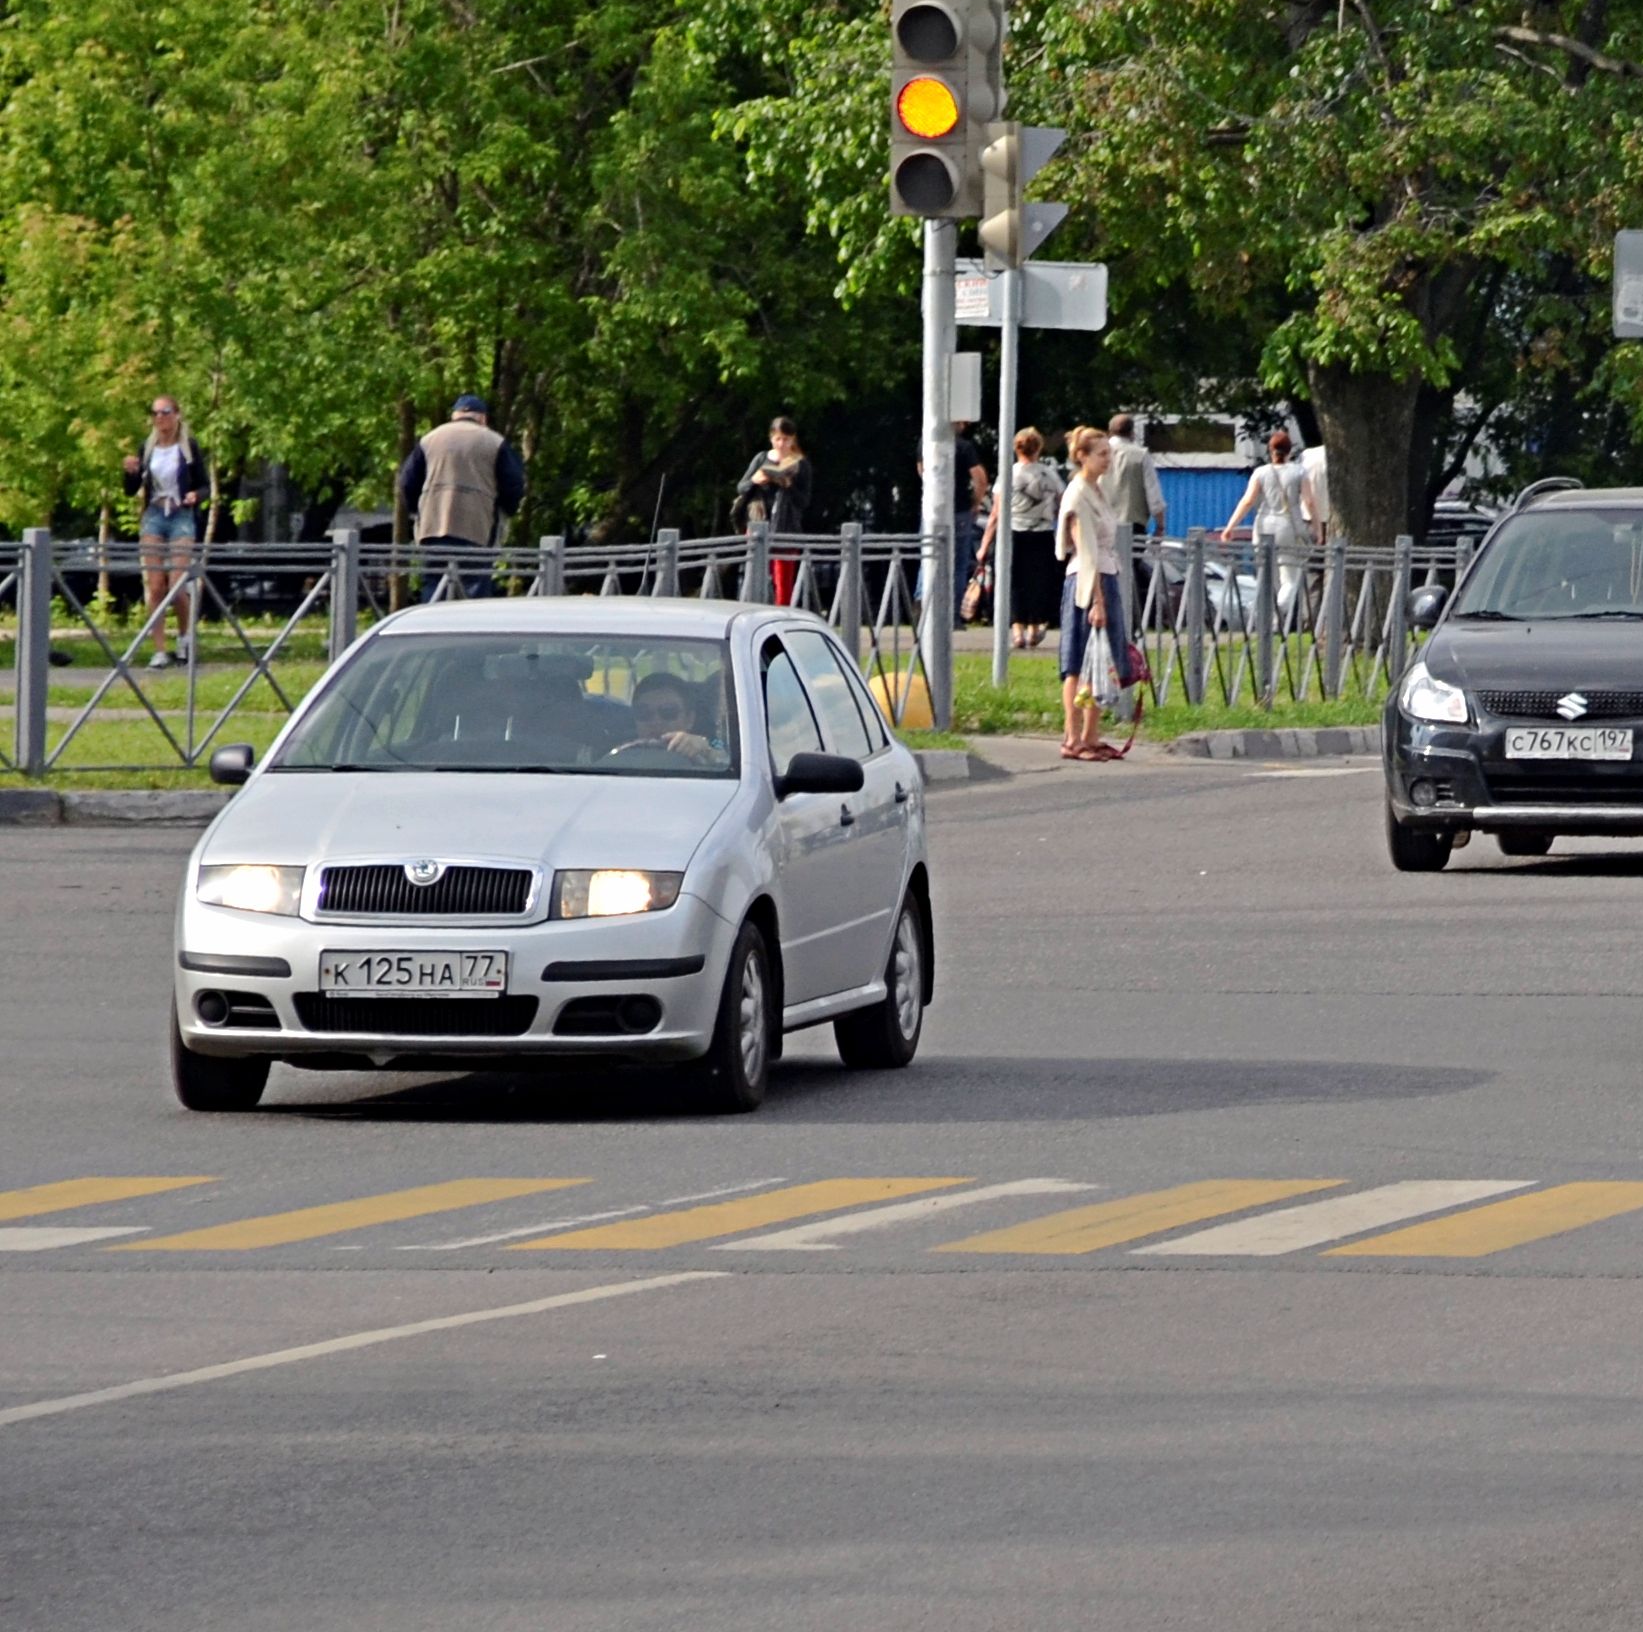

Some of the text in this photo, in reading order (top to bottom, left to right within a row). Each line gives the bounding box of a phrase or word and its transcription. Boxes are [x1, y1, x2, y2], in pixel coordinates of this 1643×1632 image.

[1512, 730, 1628, 752] С767КС 197
[465, 955, 494, 977] 77
[462, 978, 485, 987] RUS
